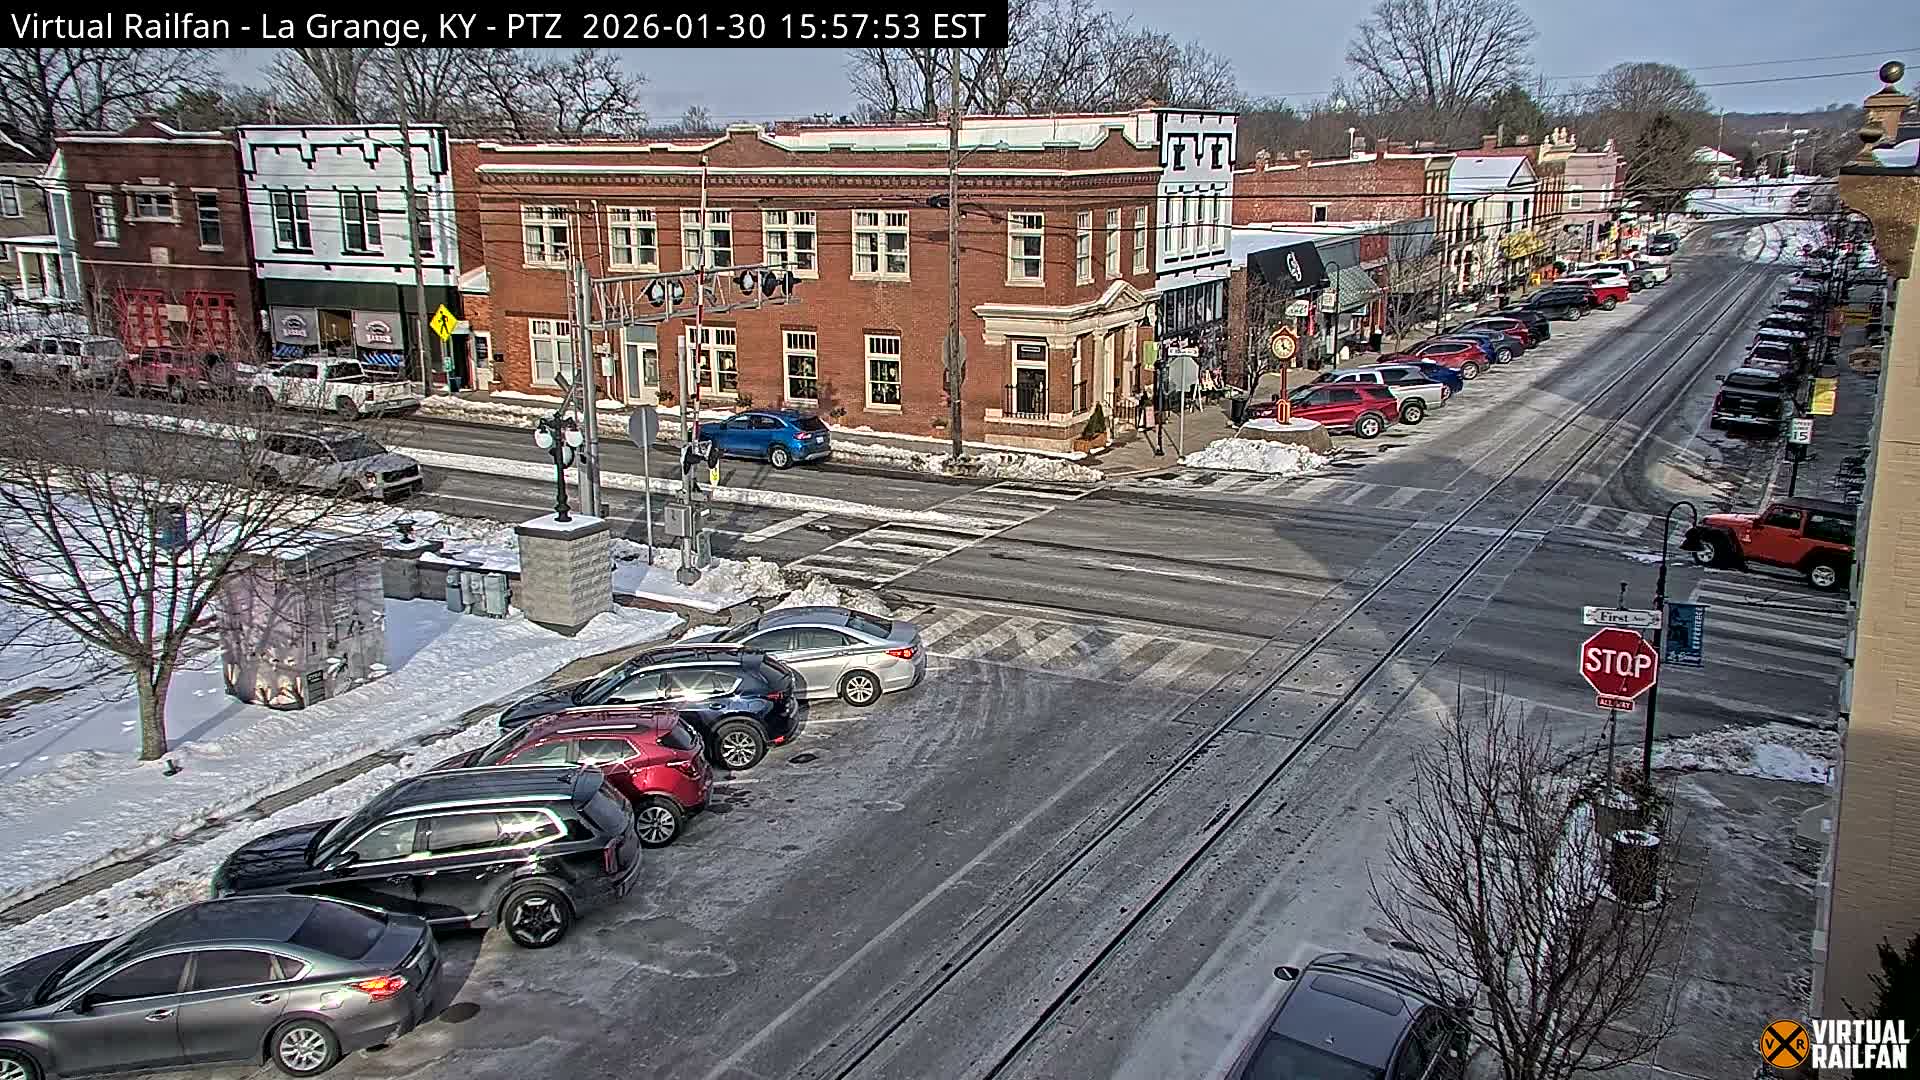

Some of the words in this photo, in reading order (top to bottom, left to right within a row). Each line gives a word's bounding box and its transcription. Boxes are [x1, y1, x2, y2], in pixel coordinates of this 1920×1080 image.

[1793, 431, 1809, 441] 15
[1600, 611, 1628, 623] First
[1585, 647, 1652, 679] STOP
[1599, 698, 1613, 708] ALL
